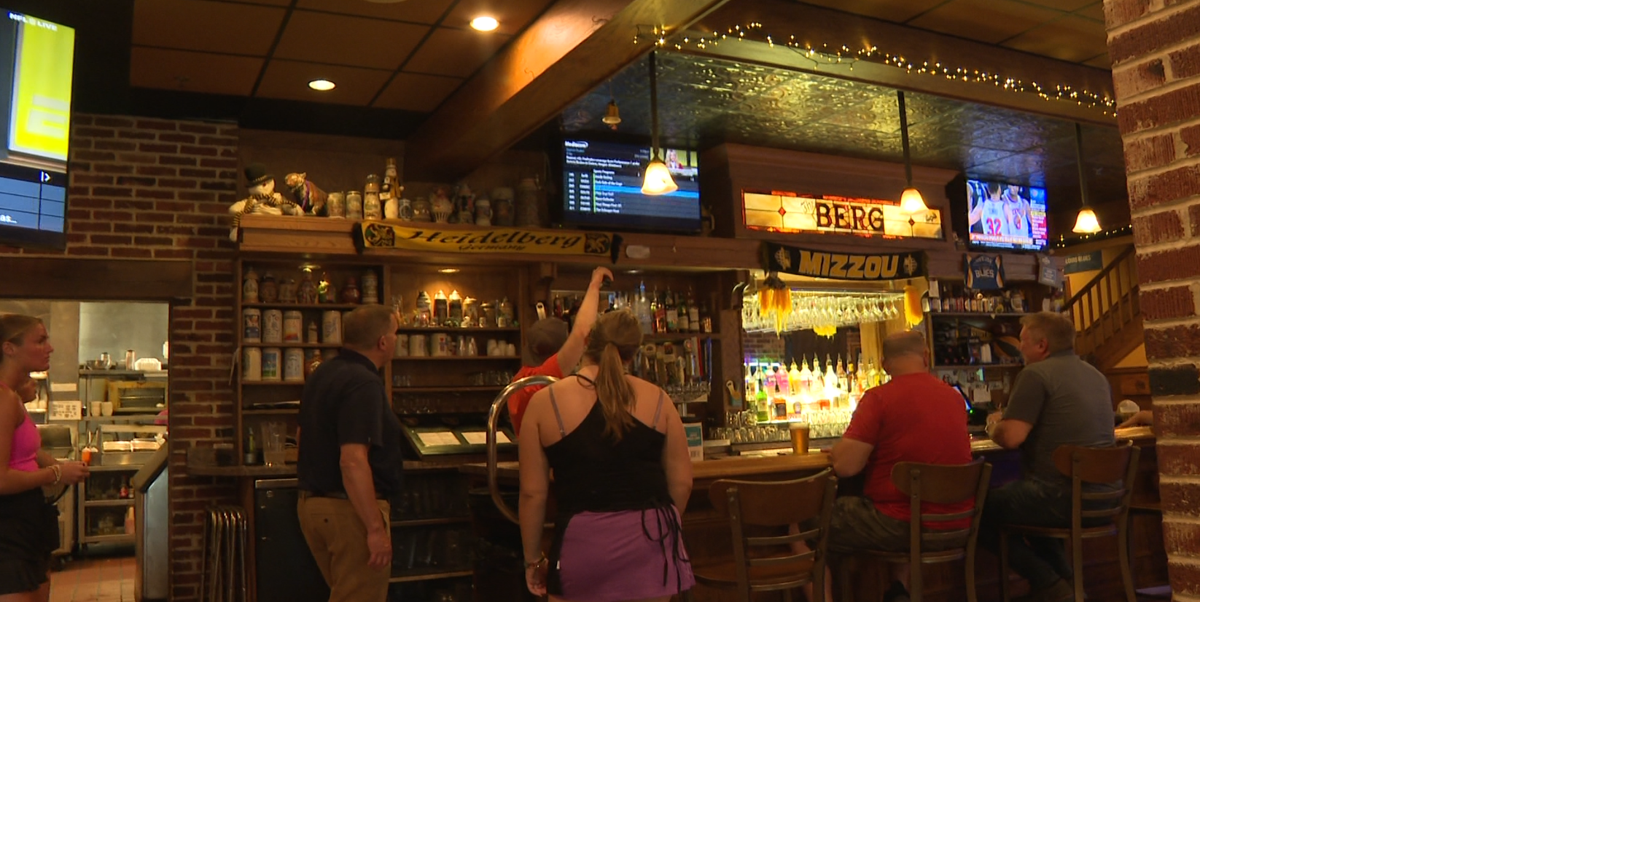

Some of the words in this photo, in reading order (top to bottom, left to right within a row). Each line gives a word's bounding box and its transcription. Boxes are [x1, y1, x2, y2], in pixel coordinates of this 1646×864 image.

[9, 12, 27, 23] NFL
[37, 21, 58, 32] LIVE
[816, 202, 885, 231] BERG
[987, 218, 1002, 236] 32
[404, 229, 582, 248] Heidelberg
[459, 243, 526, 251] Germany
[799, 250, 899, 279] MIZZOU
